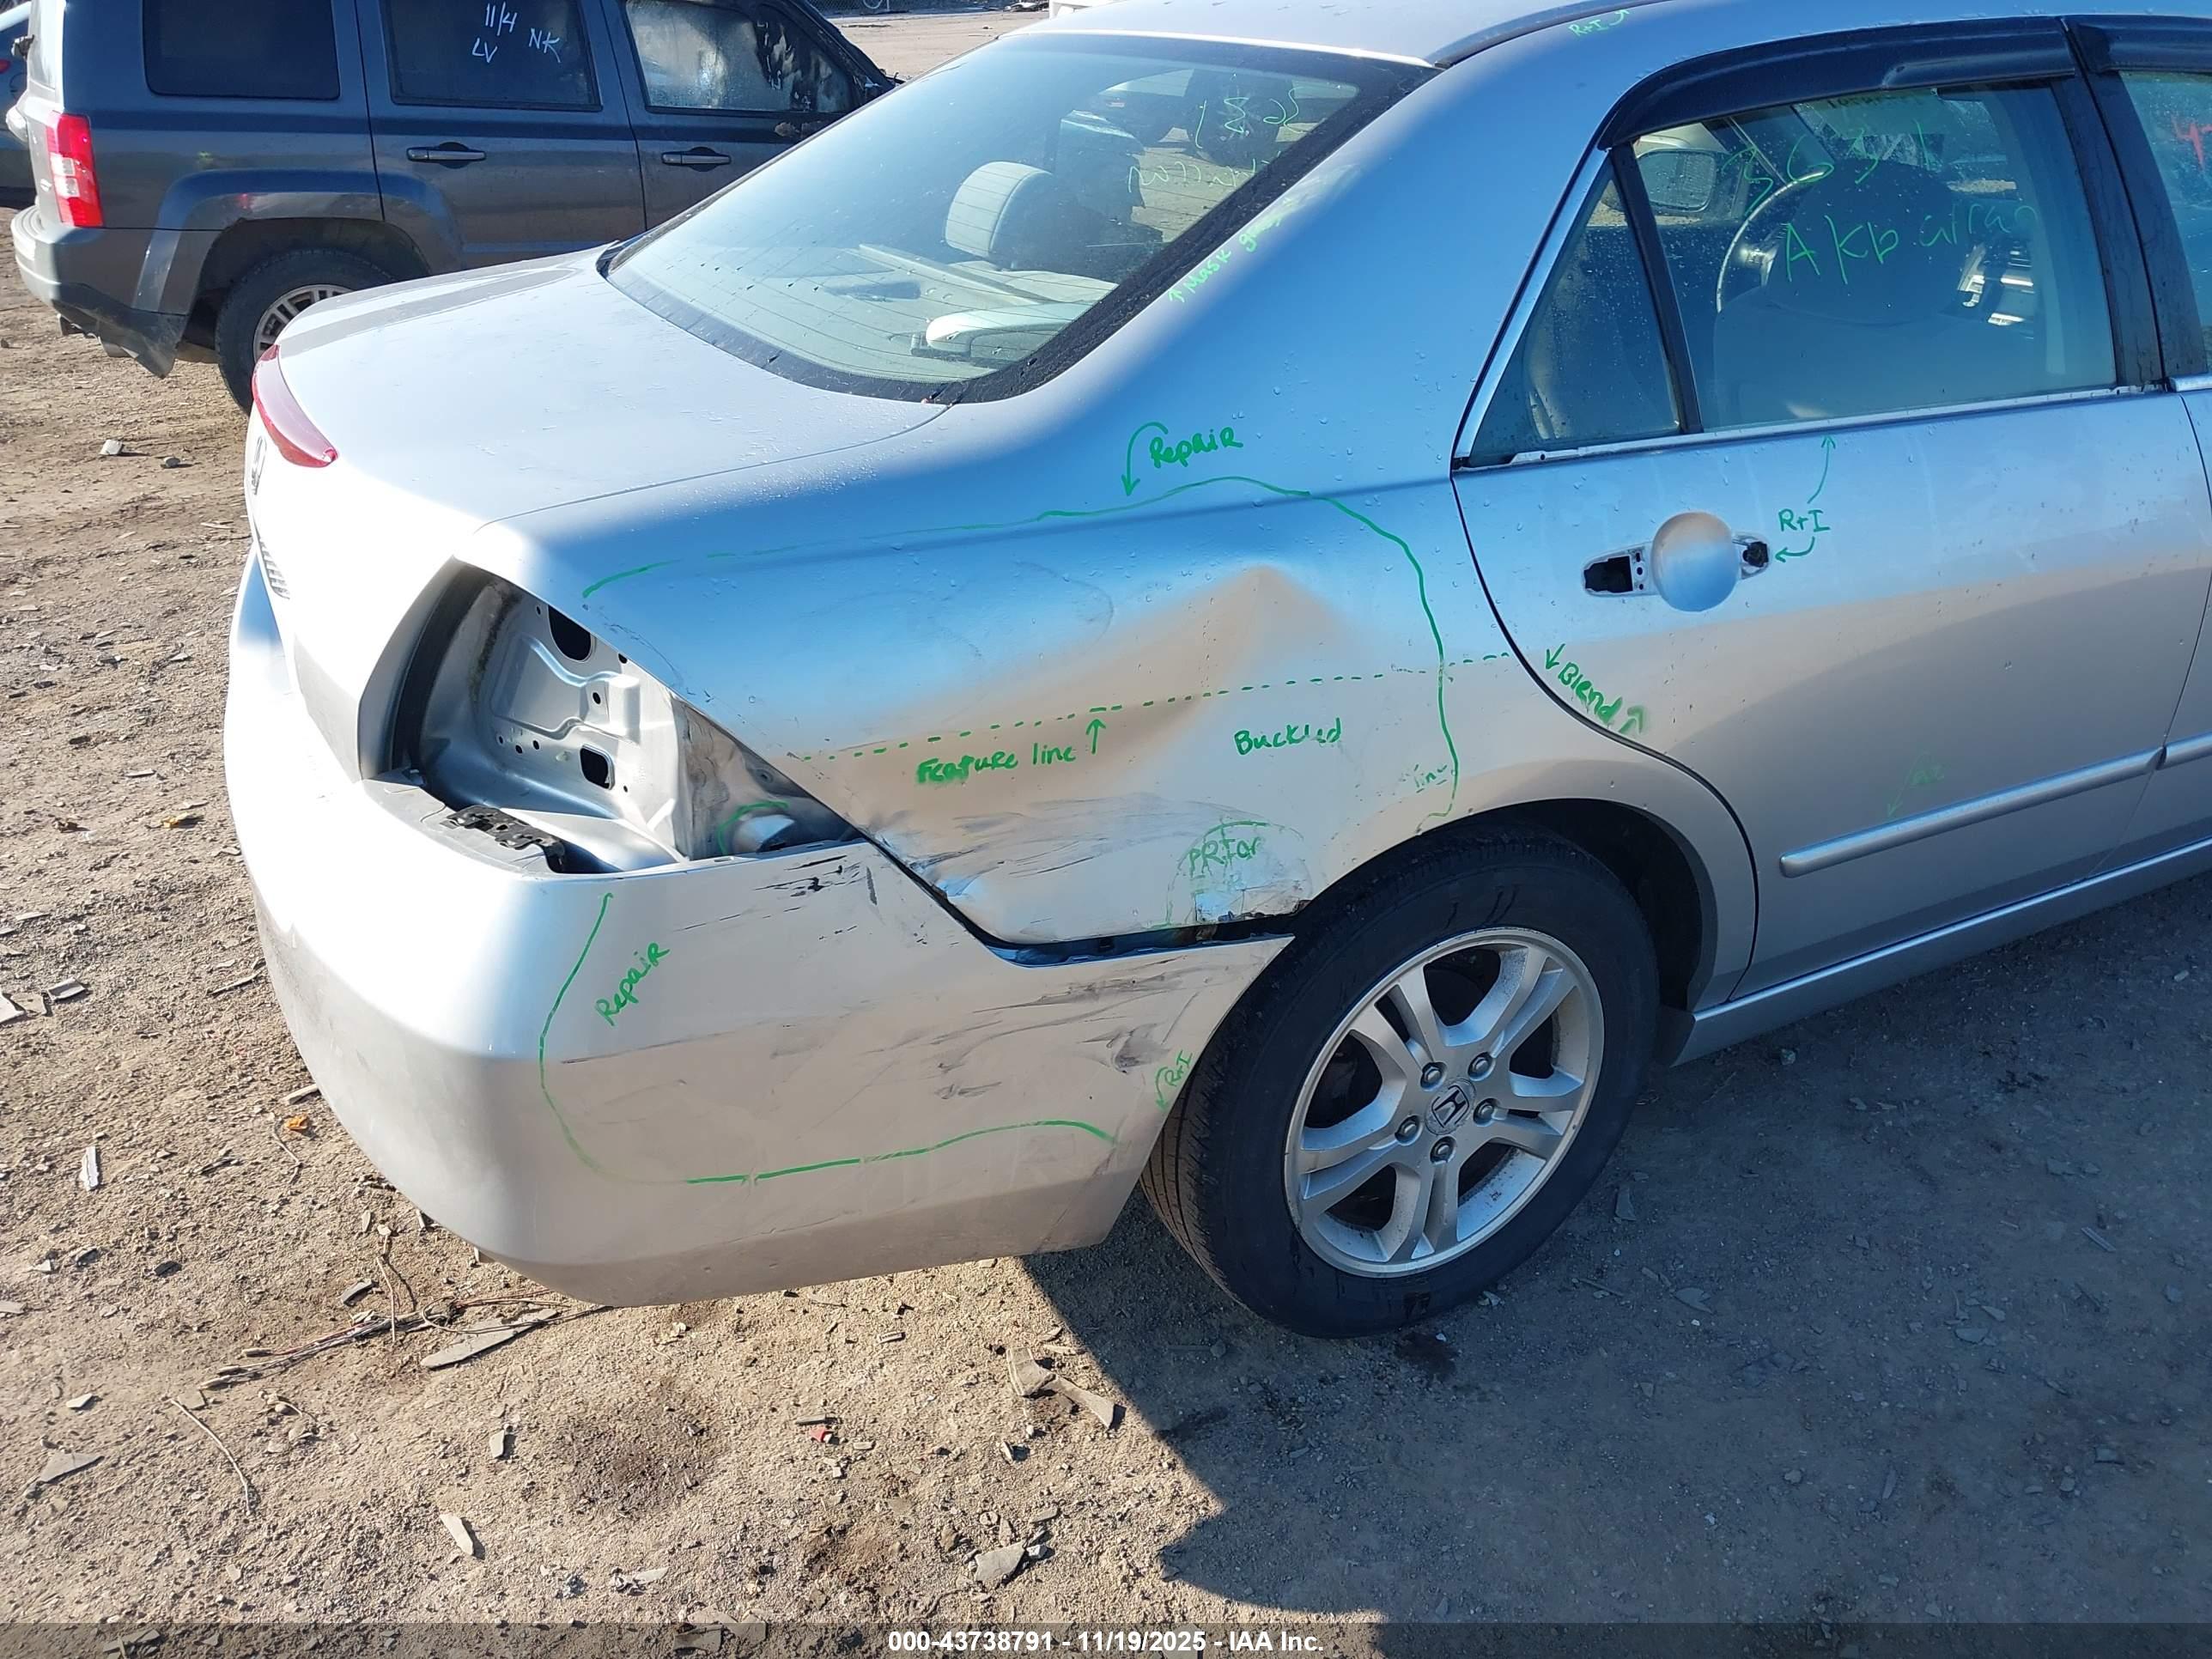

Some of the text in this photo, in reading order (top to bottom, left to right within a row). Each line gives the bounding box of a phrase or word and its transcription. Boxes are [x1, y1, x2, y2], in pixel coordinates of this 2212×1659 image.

[483, 1, 518, 36] 11/4
[471, 37, 498, 63] LV
[528, 27, 561, 63] NK
[1778, 508, 1831, 532] R+I
[1558, 661, 1623, 725] Blend
[1032, 743, 1076, 765] line
